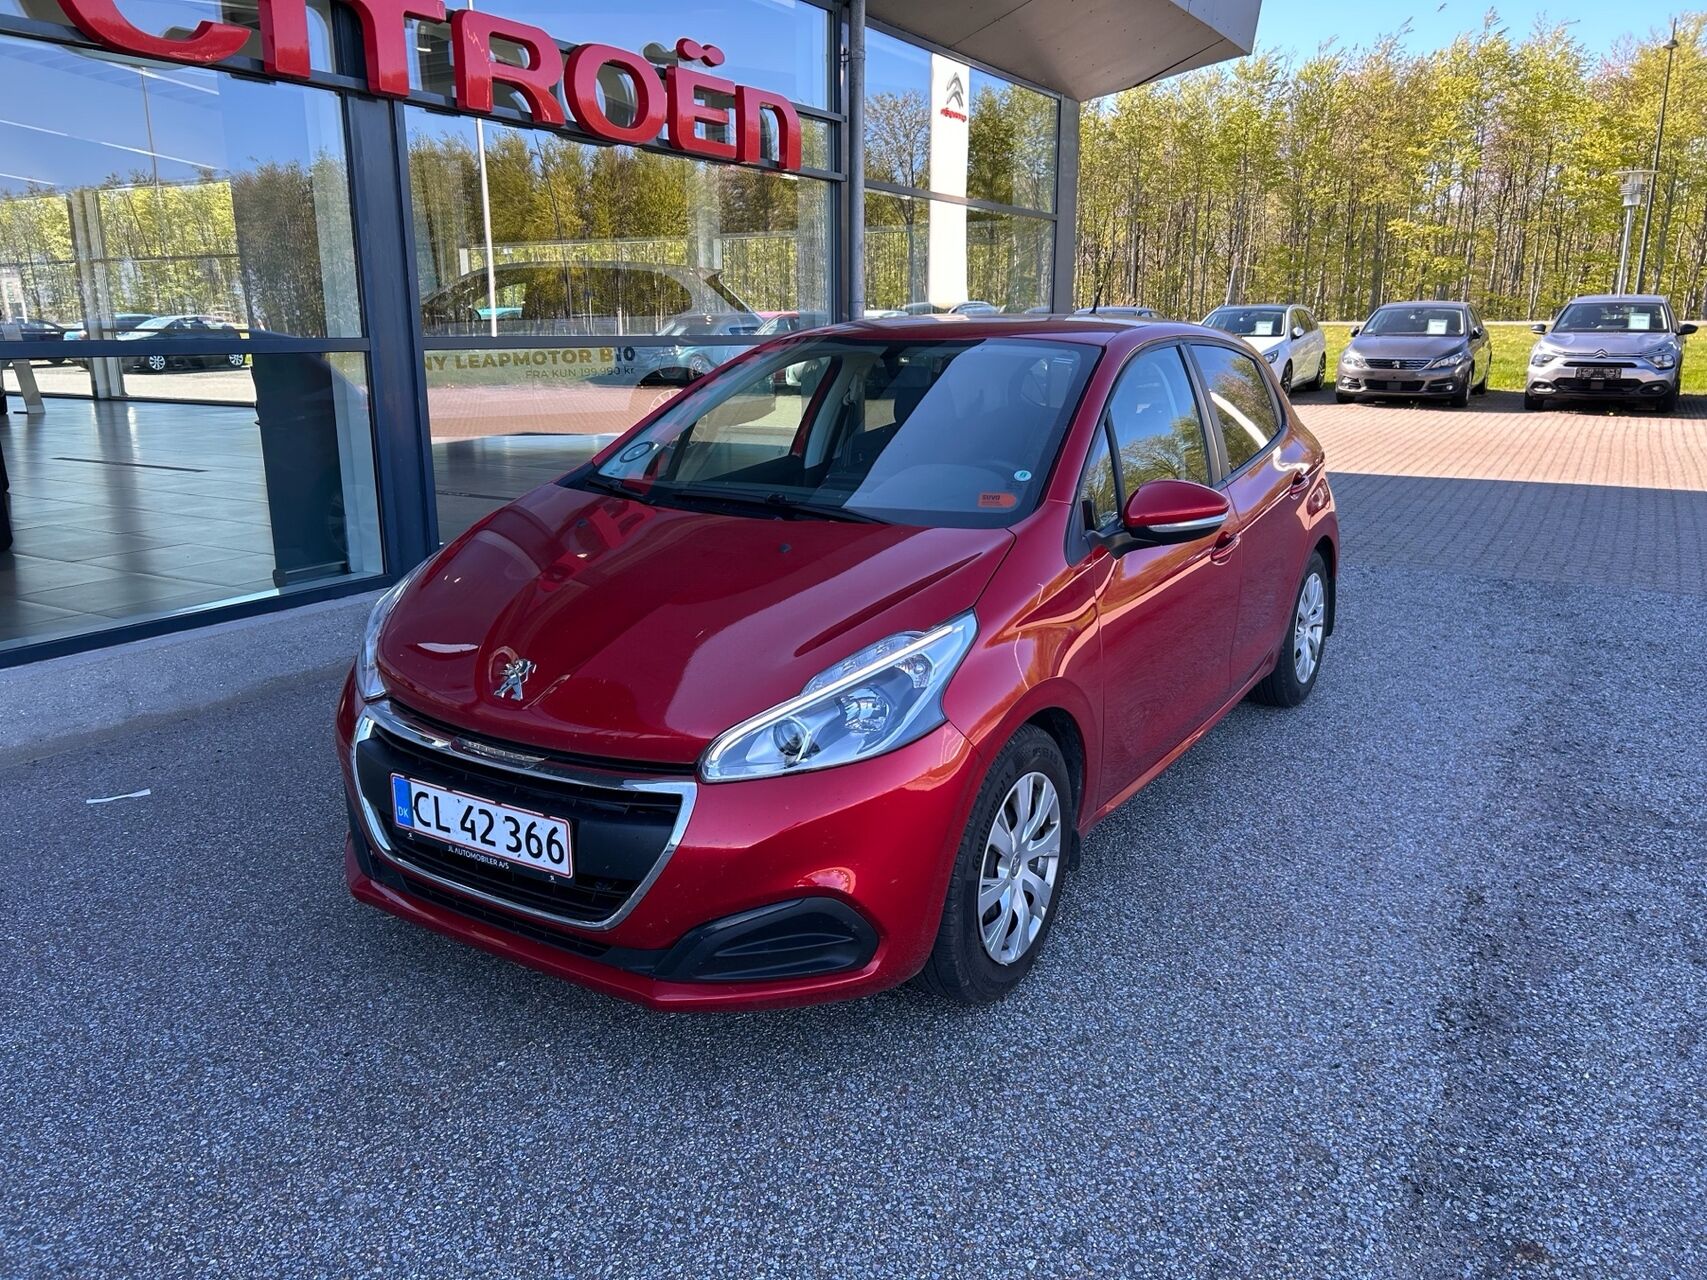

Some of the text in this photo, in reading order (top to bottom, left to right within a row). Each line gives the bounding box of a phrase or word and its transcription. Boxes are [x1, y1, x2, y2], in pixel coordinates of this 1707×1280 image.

[455, 349, 592, 369] LEAPMOTOR
[600, 346, 636, 362] B10
[525, 370, 549, 379] FRA
[552, 369, 577, 378] KUN
[398, 805, 409, 818] DK
[413, 791, 565, 865] CL 42 366
[454, 847, 498, 866] AUTOMOBILER
